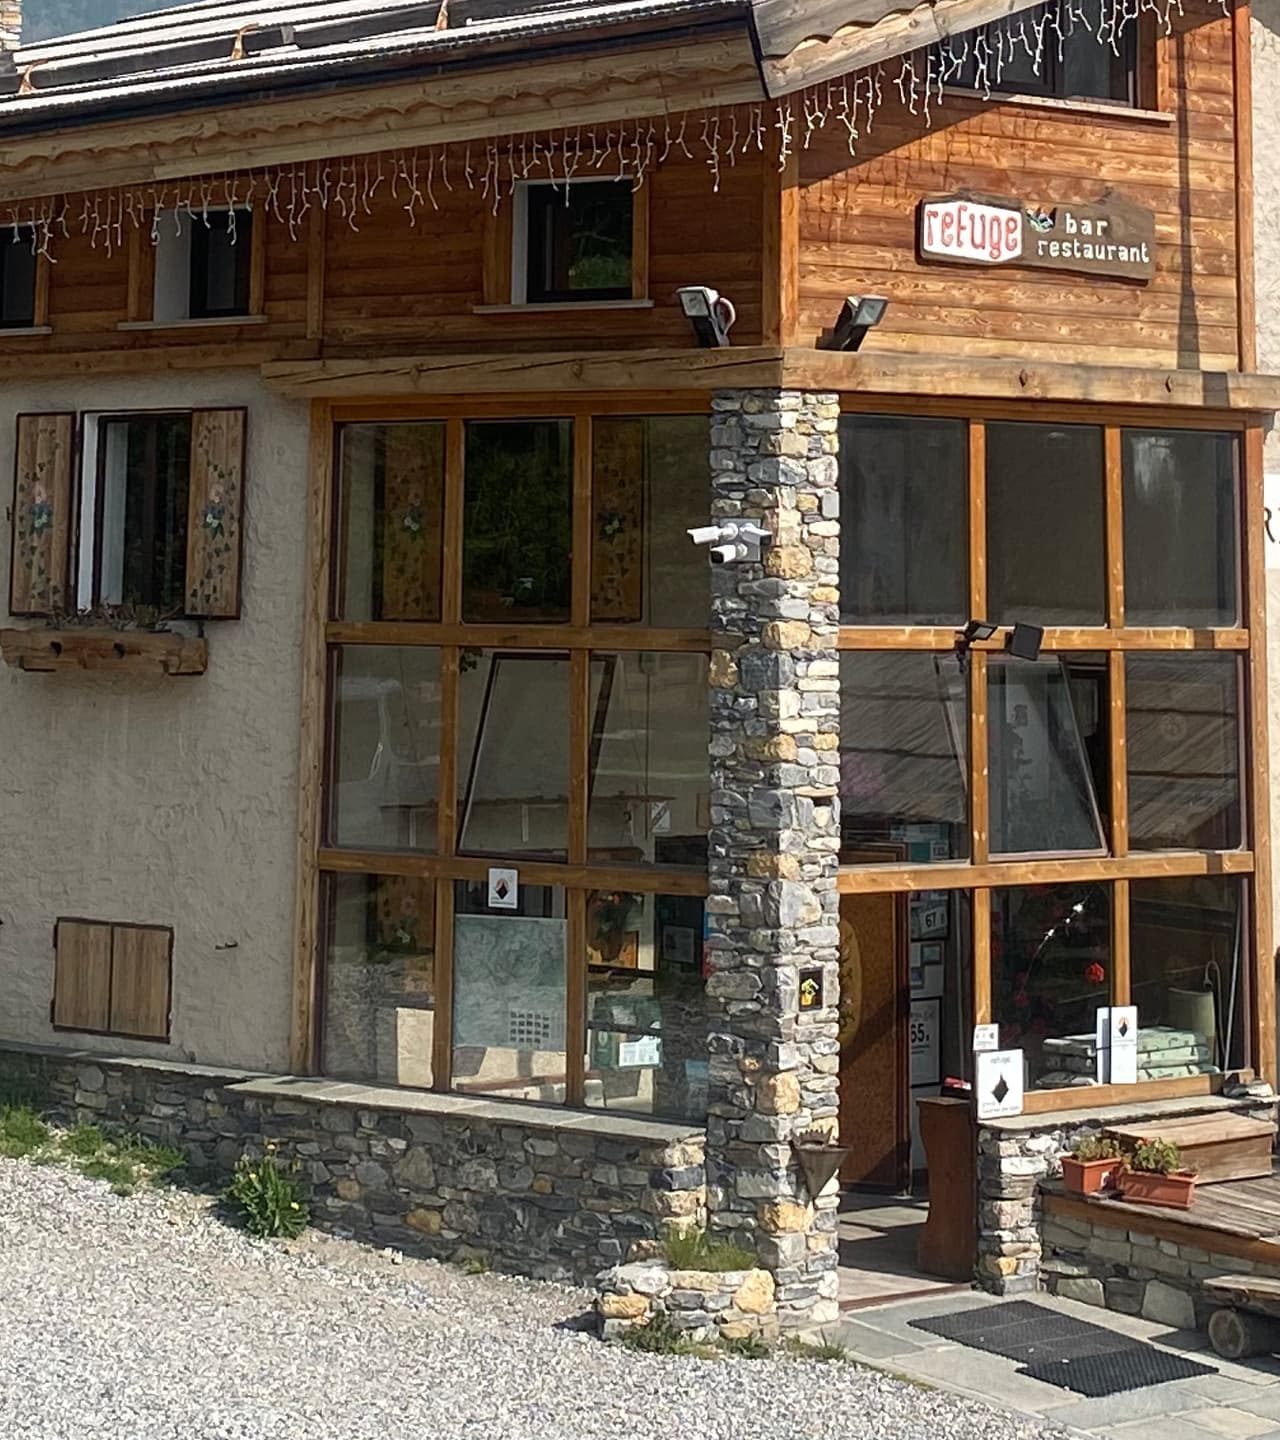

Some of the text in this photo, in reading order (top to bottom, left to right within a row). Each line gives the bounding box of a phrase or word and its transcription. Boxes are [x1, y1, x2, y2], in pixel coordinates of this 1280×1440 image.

[926, 205, 1018, 259] refuge
[1065, 213, 1108, 236] bar
[1037, 238, 1150, 263] restaurant
